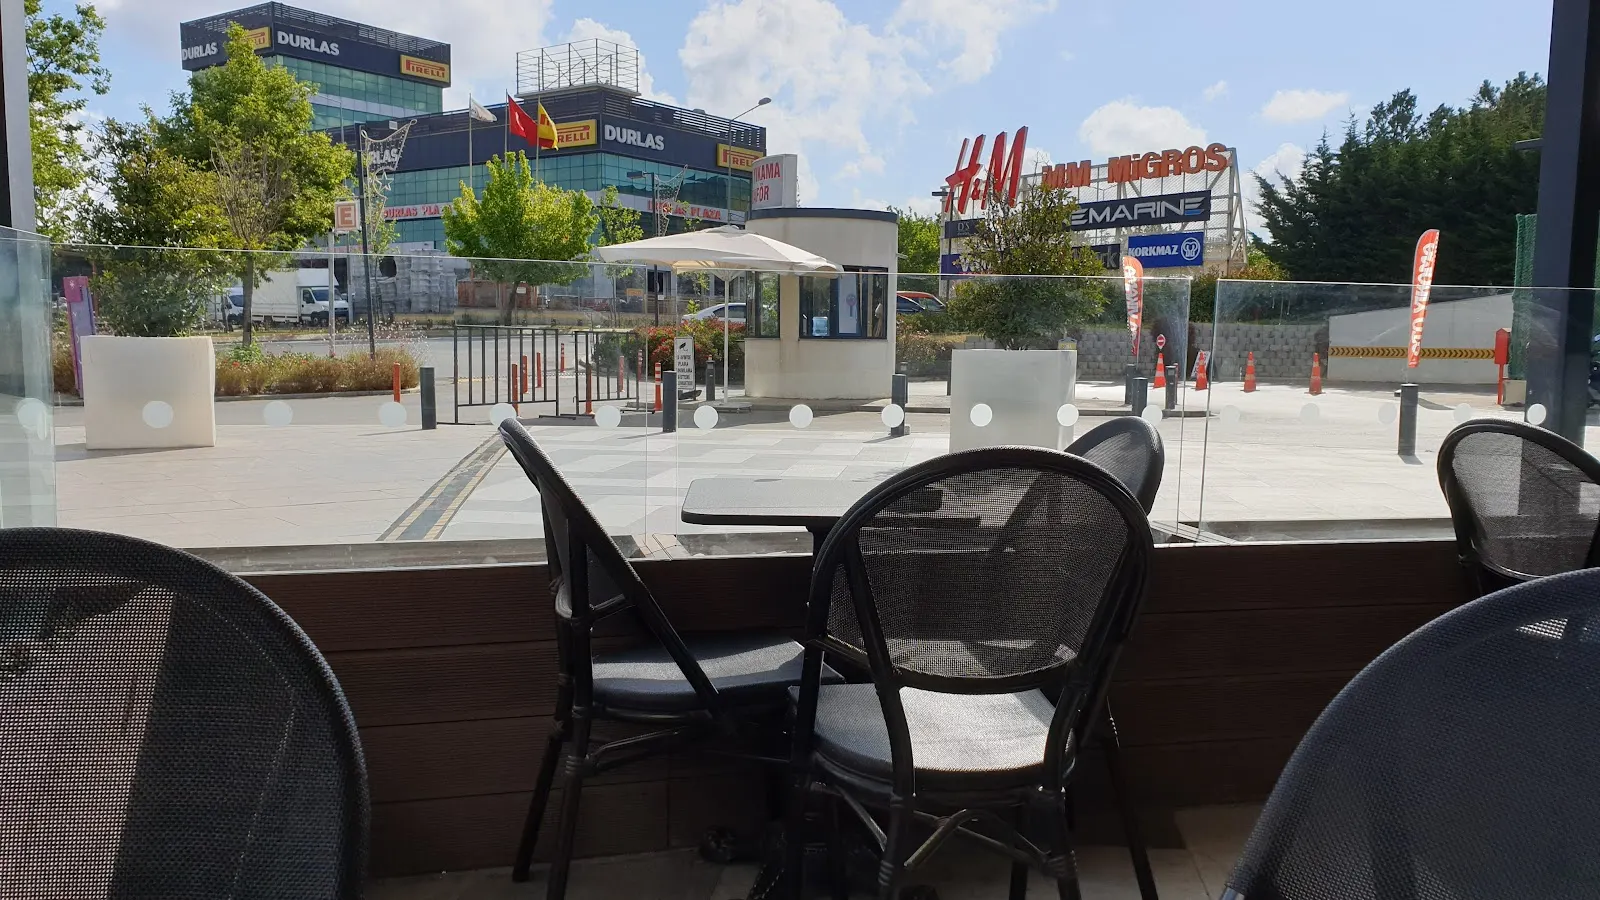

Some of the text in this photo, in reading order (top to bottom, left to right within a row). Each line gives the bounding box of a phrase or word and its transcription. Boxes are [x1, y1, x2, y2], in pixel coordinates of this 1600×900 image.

[181, 42, 218, 61] DURLAS
[277, 31, 340, 56] DURLAS
[405, 59, 446, 78] PIRELLI
[557, 126, 590, 143] RELLI
[604, 124, 665, 150] DURLAS
[945, 125, 1028, 214] H&M
[340, 206, 352, 226] E
[1071, 196, 1207, 226] EMARINE
[1128, 244, 1179, 258] KORKMAZ
